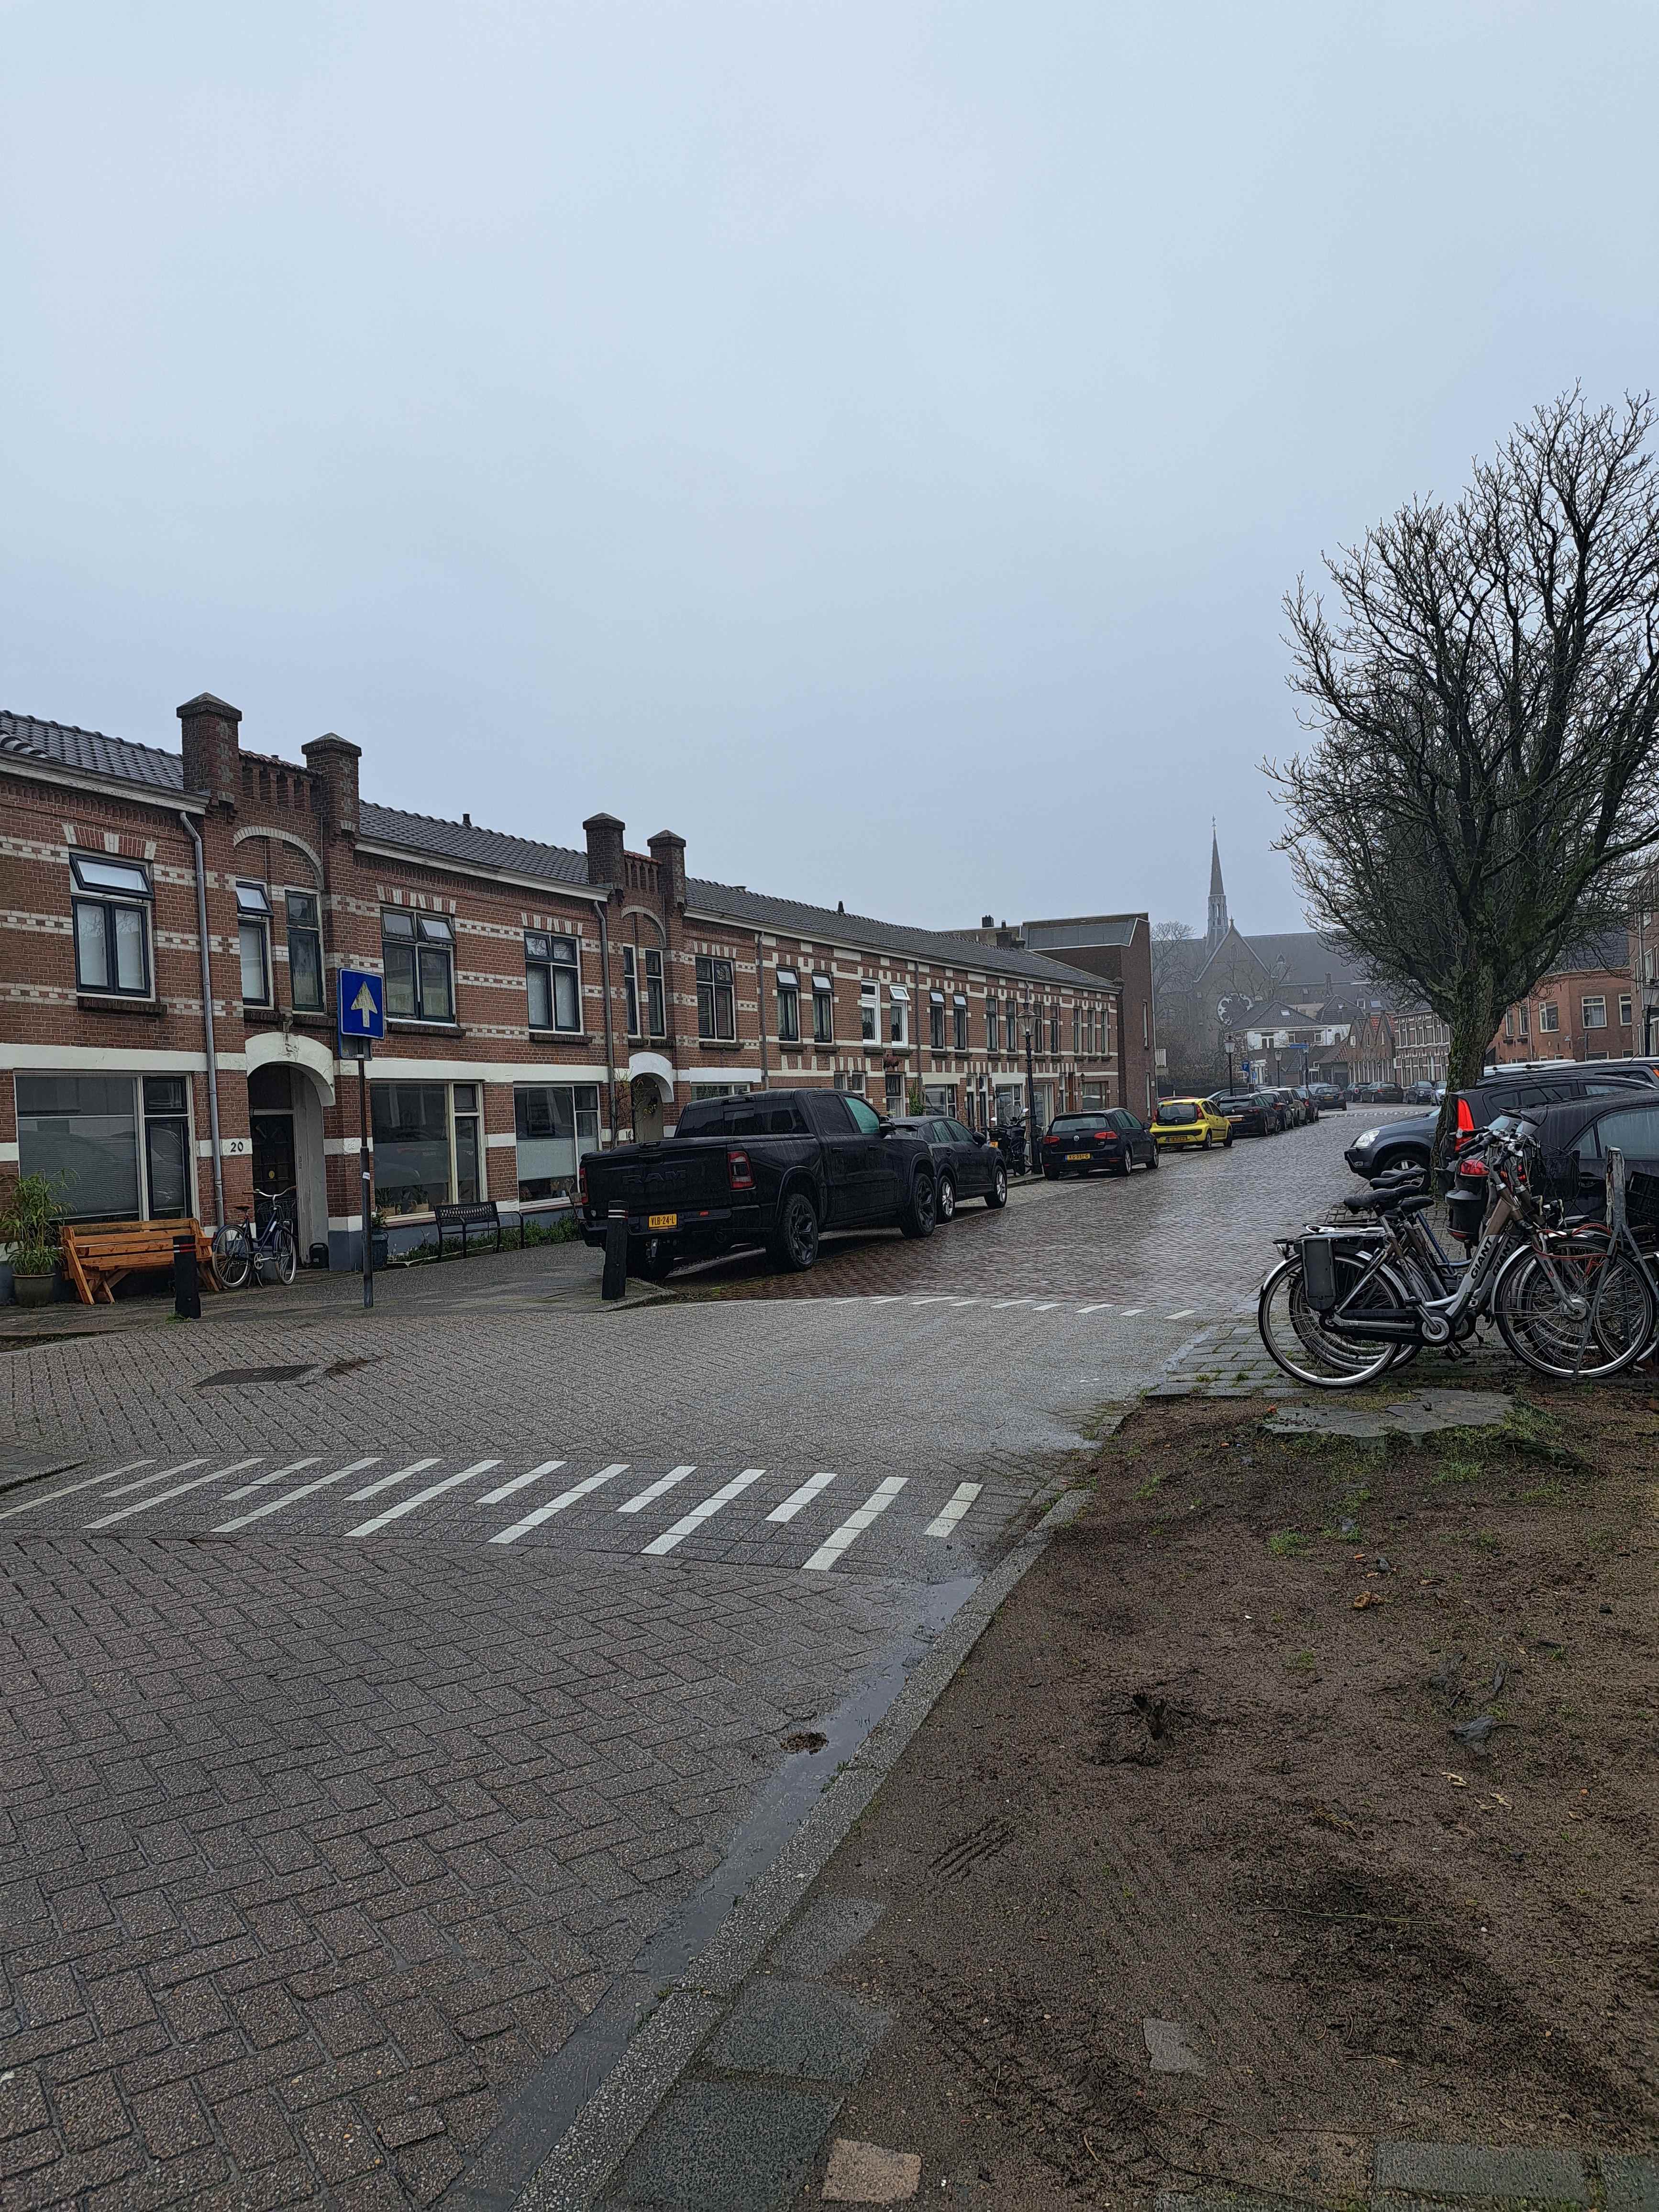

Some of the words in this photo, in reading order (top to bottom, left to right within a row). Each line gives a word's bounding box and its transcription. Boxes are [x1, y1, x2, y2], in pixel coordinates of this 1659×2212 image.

[230, 1141, 243, 1152] 20
[622, 1170, 686, 1185] RAM
[651, 1216, 675, 1226] VLB-24-L
[1471, 1236, 1493, 1279] GIANT
